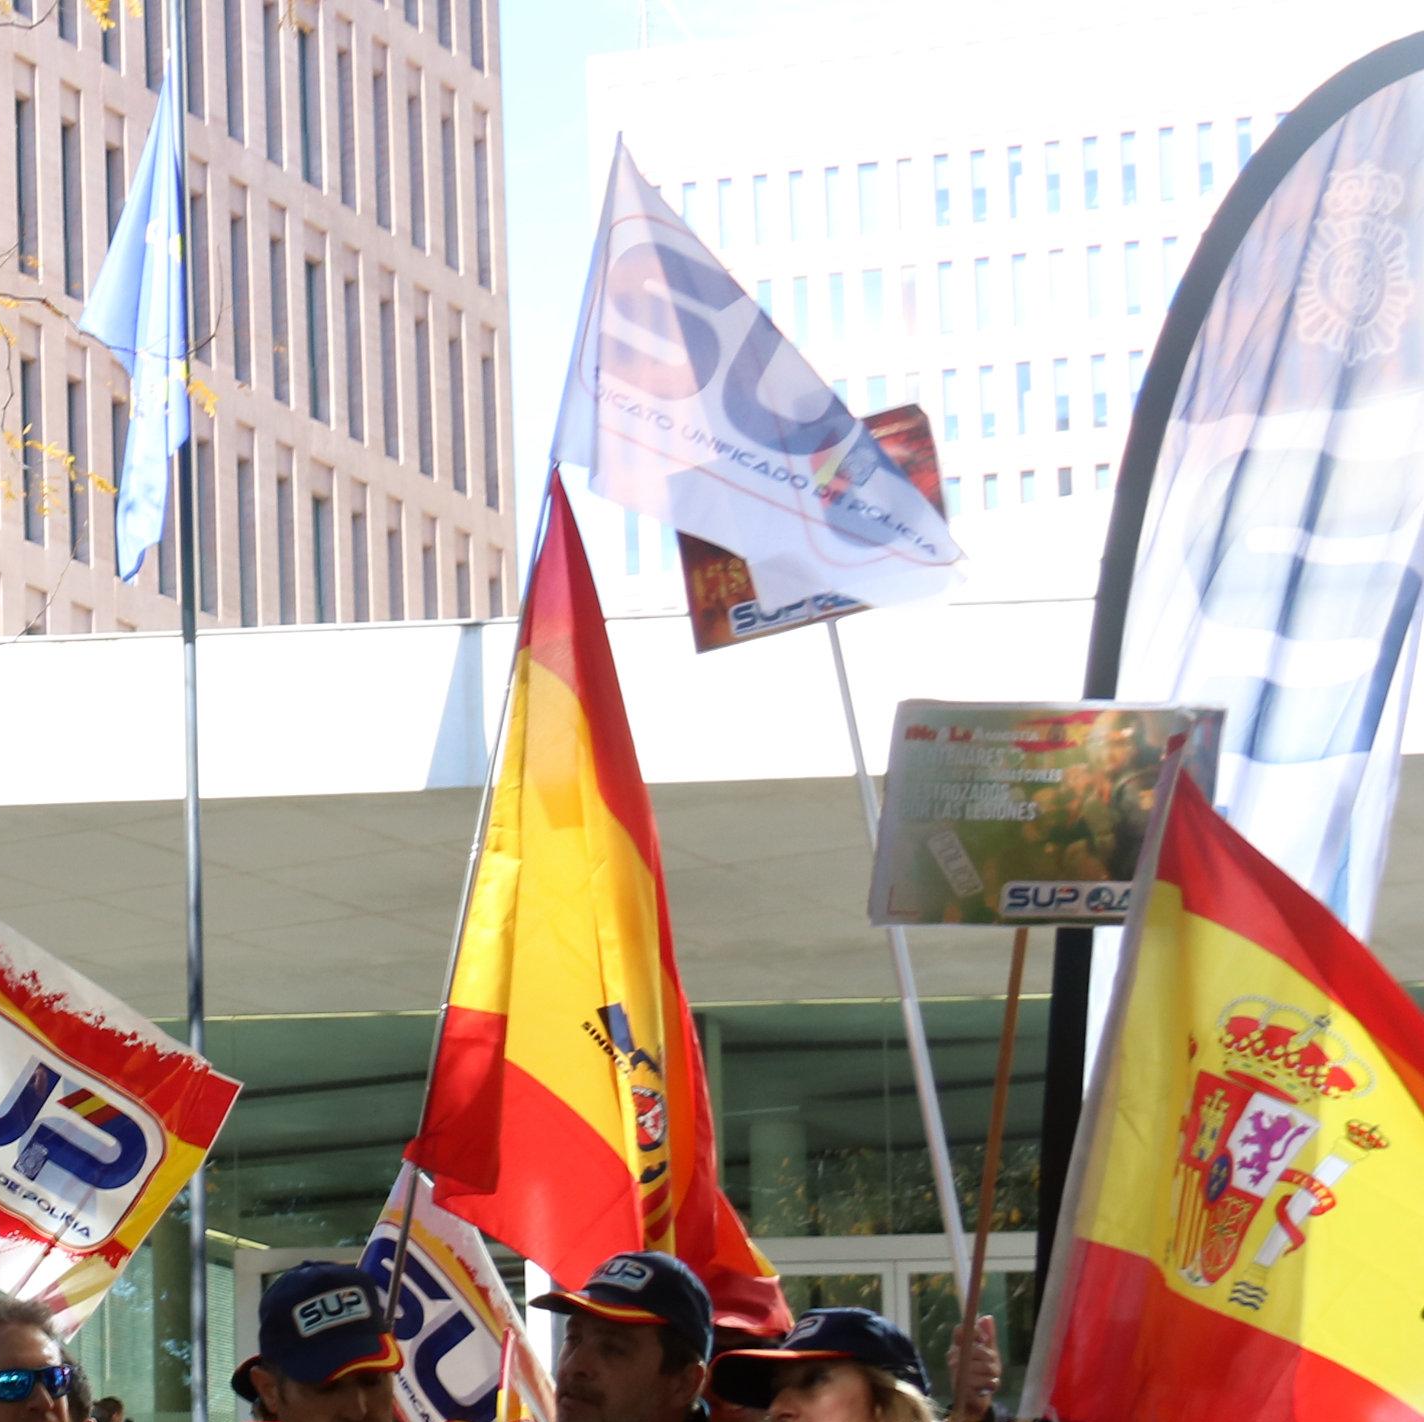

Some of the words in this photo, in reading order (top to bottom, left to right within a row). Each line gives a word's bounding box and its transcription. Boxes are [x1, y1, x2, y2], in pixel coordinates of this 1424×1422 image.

[1007, 886, 1080, 909] SUP
[22, 1191, 91, 1239] POLICIA
[299, 1291, 361, 1329] SUP
